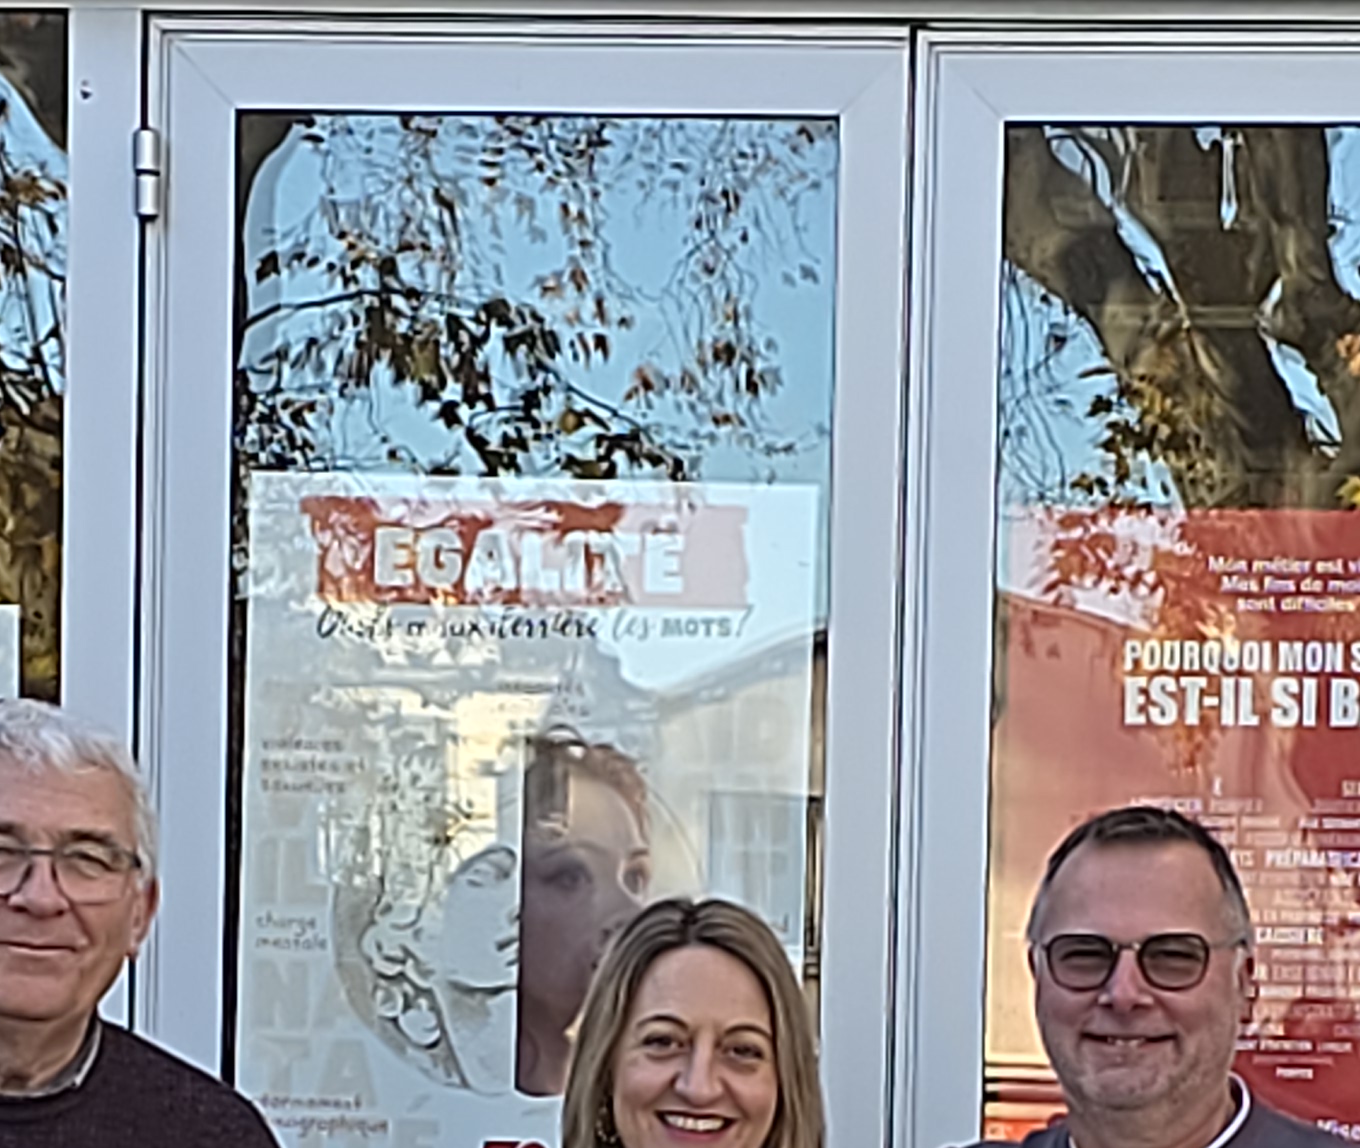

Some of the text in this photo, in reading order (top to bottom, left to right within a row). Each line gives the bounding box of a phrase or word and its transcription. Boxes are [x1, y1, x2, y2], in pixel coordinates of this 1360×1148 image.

[1208, 556, 1248, 573] Mon
[1316, 558, 1344, 574] est
[1221, 576, 1259, 592] Mes
[1264, 576, 1296, 592] fins
[1300, 577, 1324, 592] de
[1238, 596, 1356, 612] sont difficiles
[1124, 640, 1272, 674] POURQUOI
[1278, 641, 1344, 673] MON
[1124, 676, 1260, 726] EST-IL
[1271, 678, 1318, 727] SI
